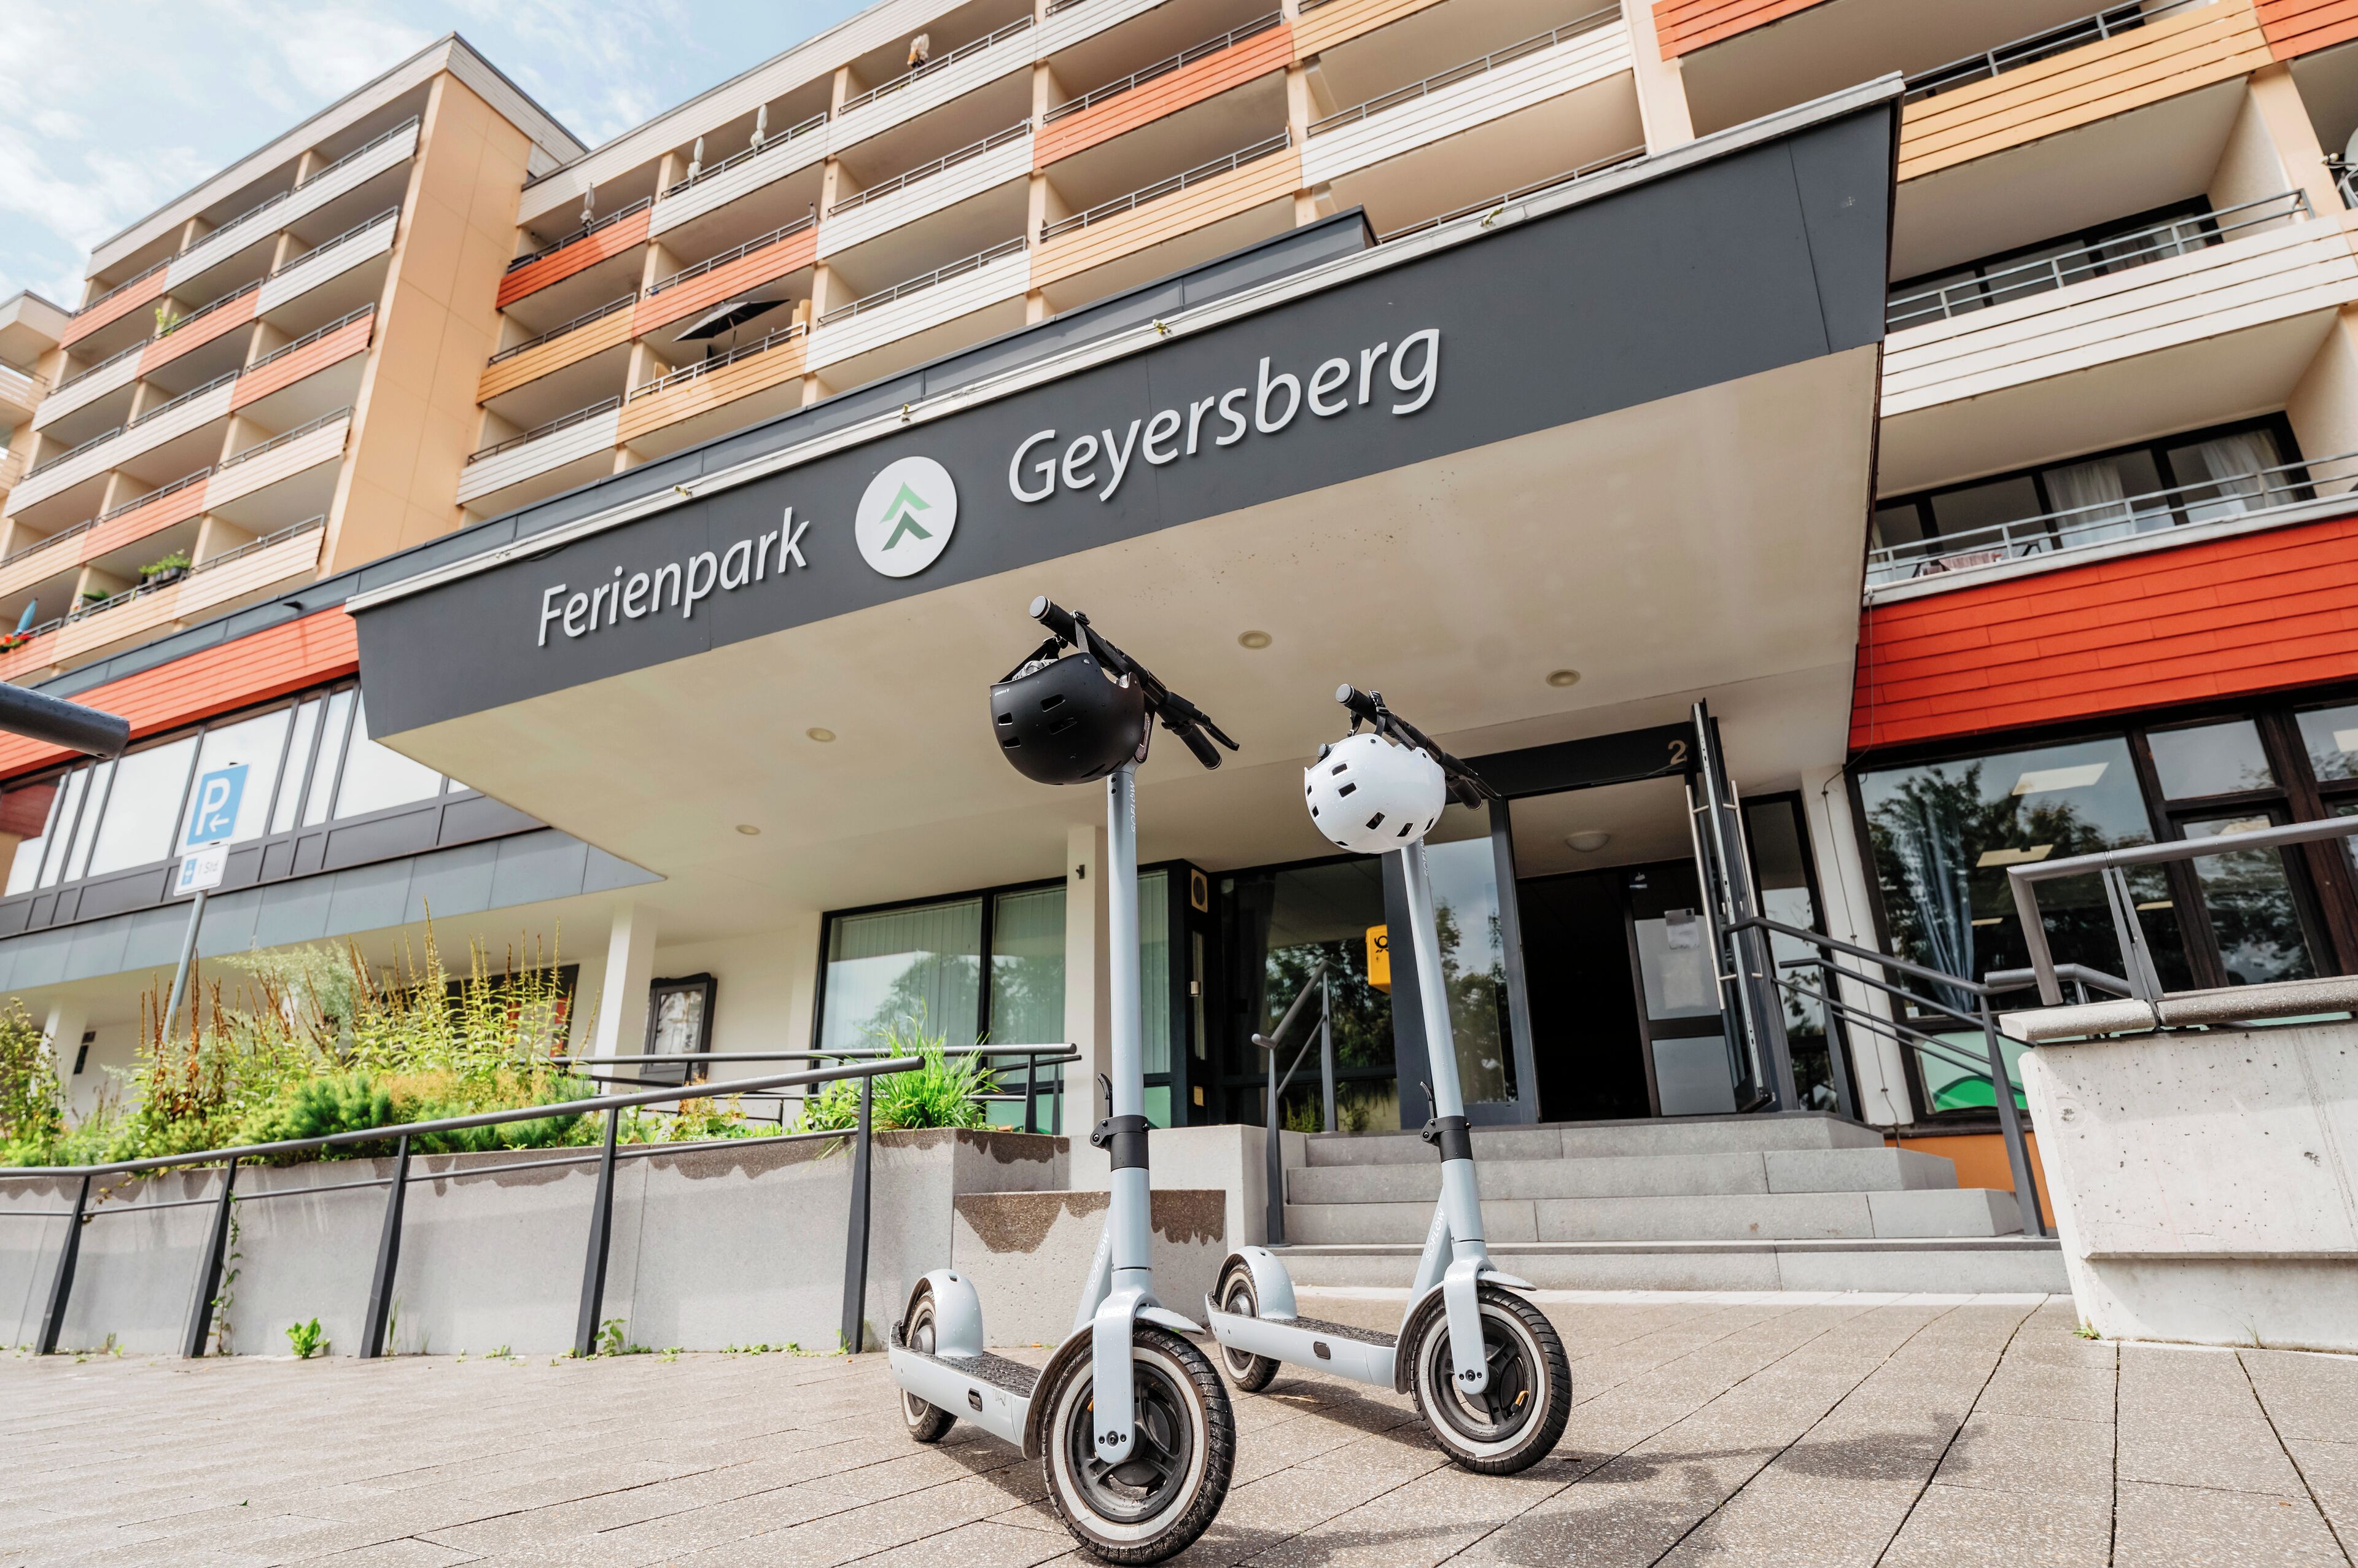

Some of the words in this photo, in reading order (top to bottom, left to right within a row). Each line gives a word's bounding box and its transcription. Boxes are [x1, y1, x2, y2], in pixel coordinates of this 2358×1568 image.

[537, 506, 810, 646] Ferienpark
[1008, 328, 1440, 503] Geyersberg
[1668, 740, 1687, 766] 2
[195, 777, 230, 836] P
[1088, 1227, 1109, 1293] SOFLOW
[1426, 1208, 1444, 1262] SOFLOW
